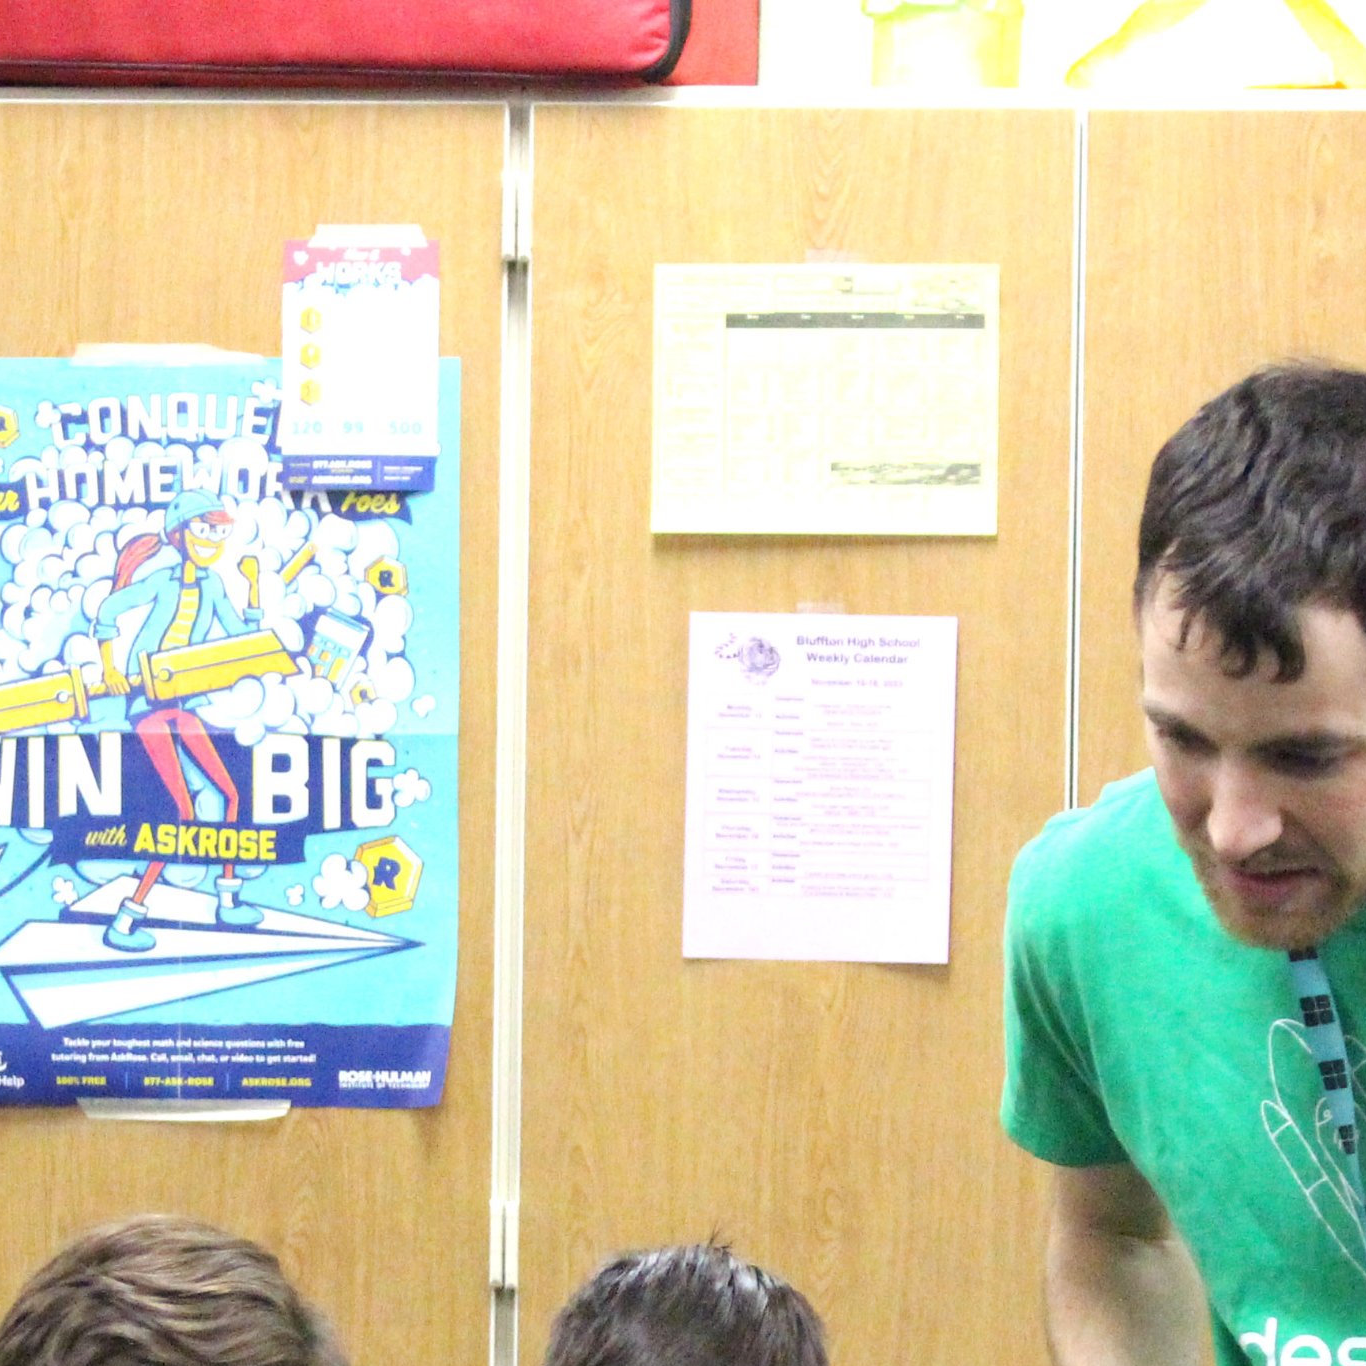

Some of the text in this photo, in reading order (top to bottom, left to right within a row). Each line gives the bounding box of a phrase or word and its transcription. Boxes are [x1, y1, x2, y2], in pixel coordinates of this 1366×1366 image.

[49, 393, 282, 449] CONQUE
[796, 635, 921, 649] Bluffton High School
[806, 652, 908, 665] Weekly Calendar
[252, 736, 396, 831] BIG
[84, 823, 278, 861] with ASKROSE
[91, 1038, 111, 1048] your
[152, 1038, 175, 1047] math
[267, 1038, 286, 1048] with
[255, 1054, 265, 1062] to
[266, 1054, 281, 1065] get
